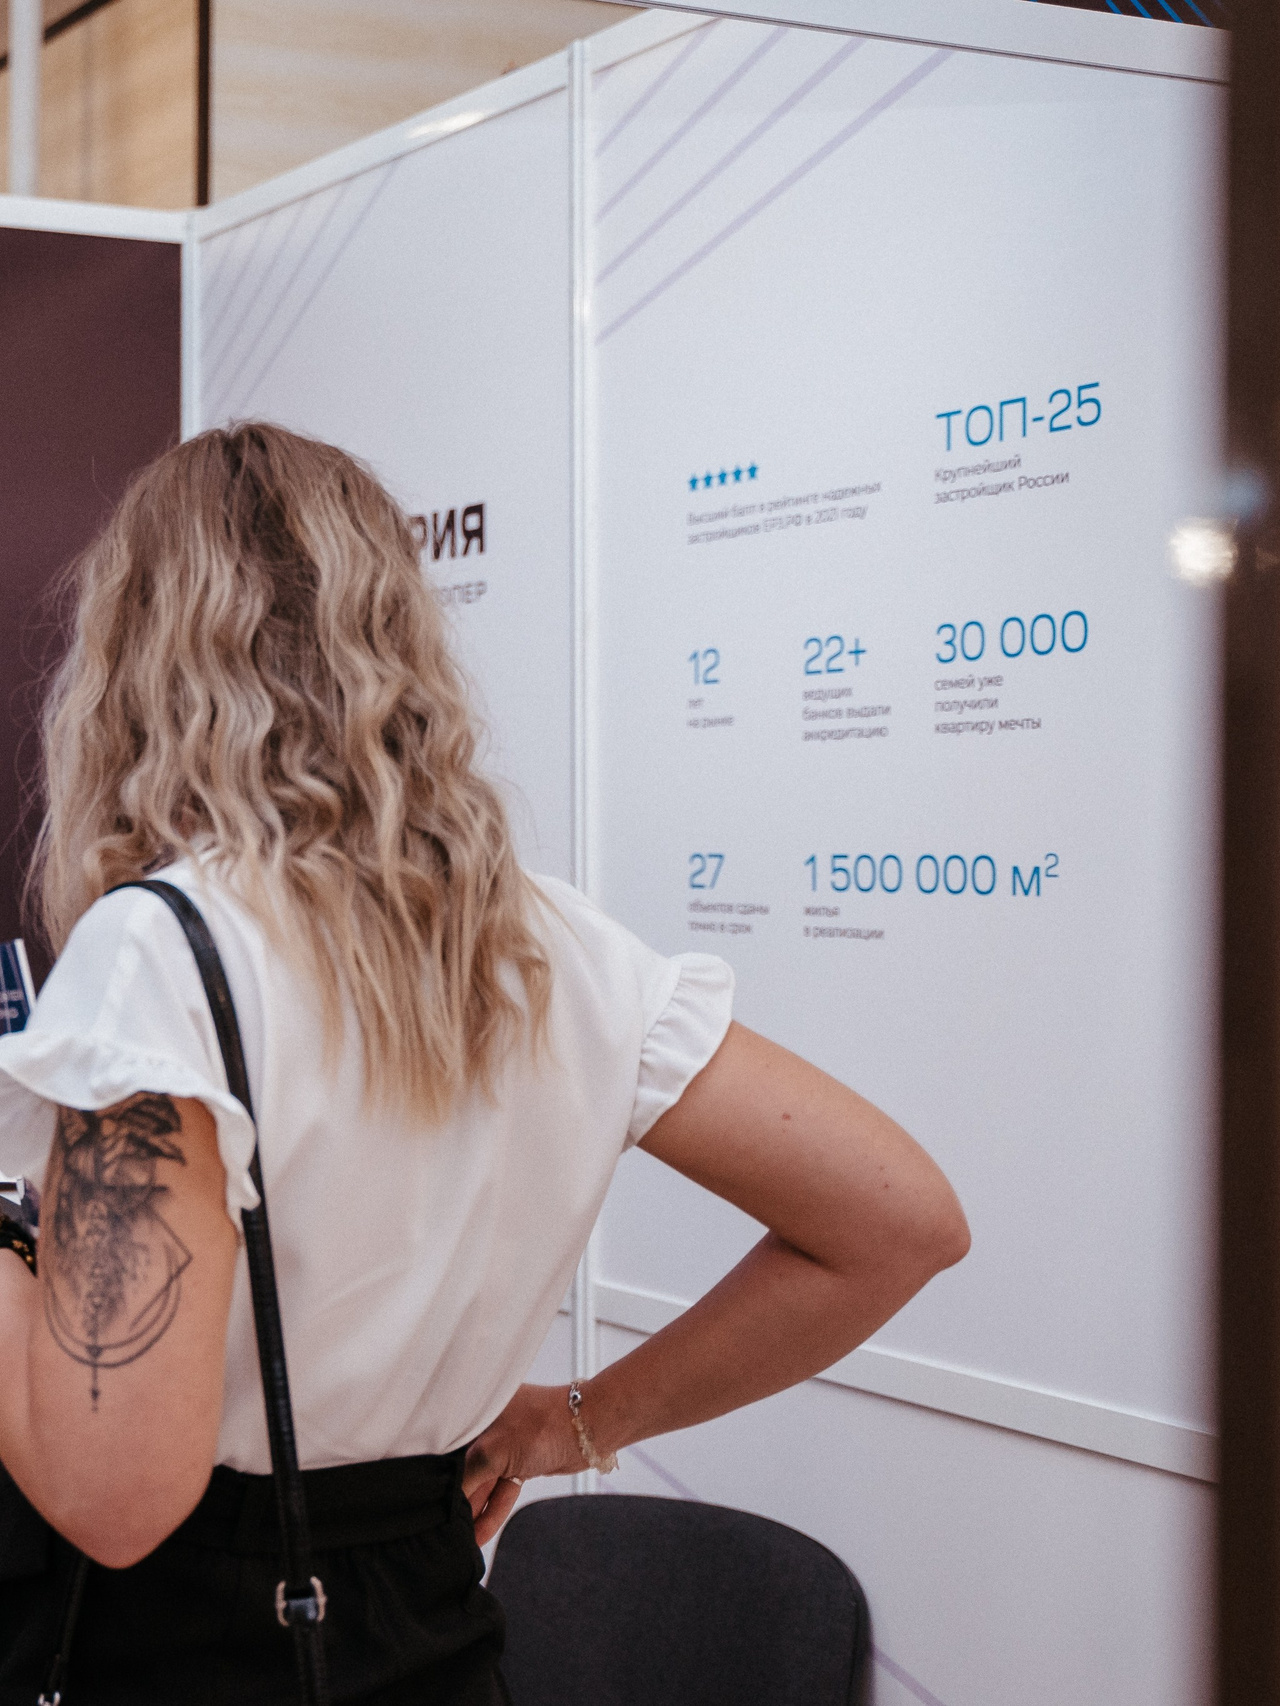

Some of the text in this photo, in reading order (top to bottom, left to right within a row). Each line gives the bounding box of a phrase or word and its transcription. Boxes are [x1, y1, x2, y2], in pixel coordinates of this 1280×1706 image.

[935, 381, 1102, 452] ТОП-25
[934, 454, 1022, 484] Крупнейший
[934, 471, 1070, 505] застройщик России
[935, 610, 1088, 664] 30 000
[687, 647, 720, 685] 12
[803, 635, 867, 676] 22+
[934, 674, 1005, 692] семей уже
[802, 704, 892, 721] банков выдали
[934, 698, 1000, 715] получили
[934, 717, 1042, 736] квартиру мечты
[688, 853, 725, 890] 27
[916, 855, 997, 896] 000
